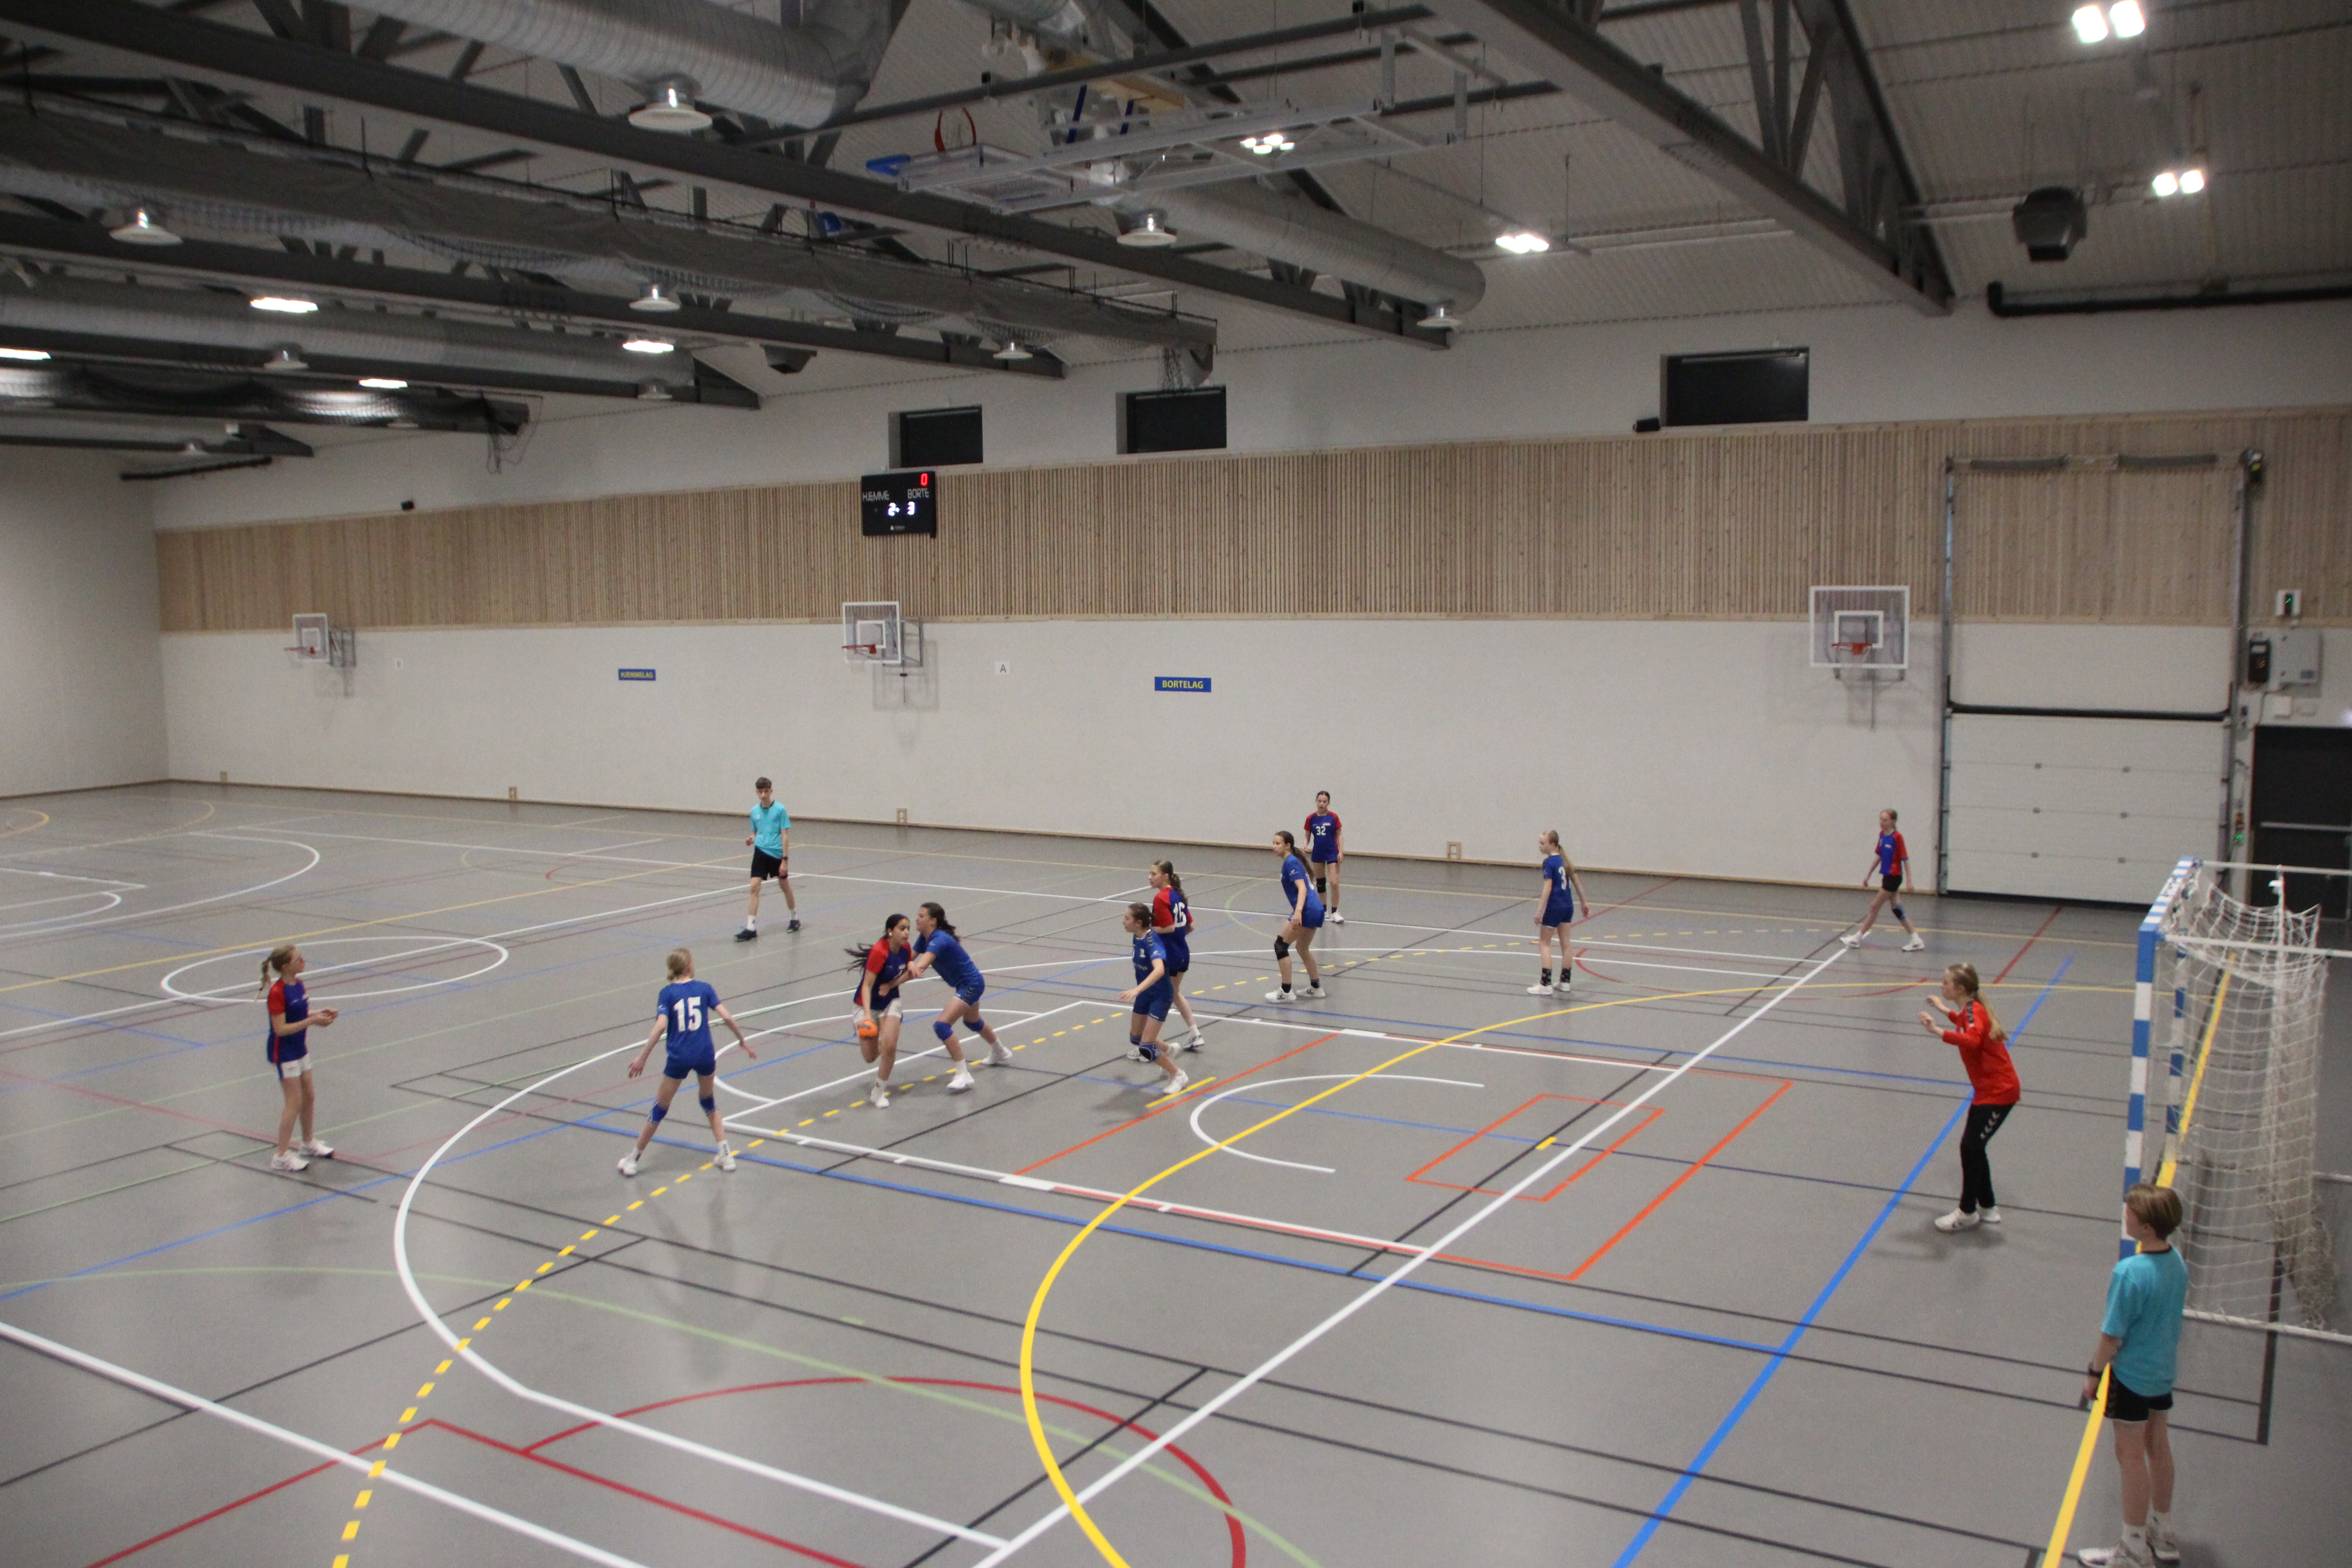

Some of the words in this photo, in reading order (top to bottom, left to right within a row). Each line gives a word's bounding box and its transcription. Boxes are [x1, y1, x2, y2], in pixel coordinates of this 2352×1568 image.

[920, 473, 928, 486] 0
[907, 488, 929, 499] BORTE
[907, 501, 915, 515] 3
[1000, 664, 1006, 673] A
[1162, 680, 1204, 689] BORTELAG
[1315, 826, 1326, 836] 32
[673, 996, 702, 1032] 15
